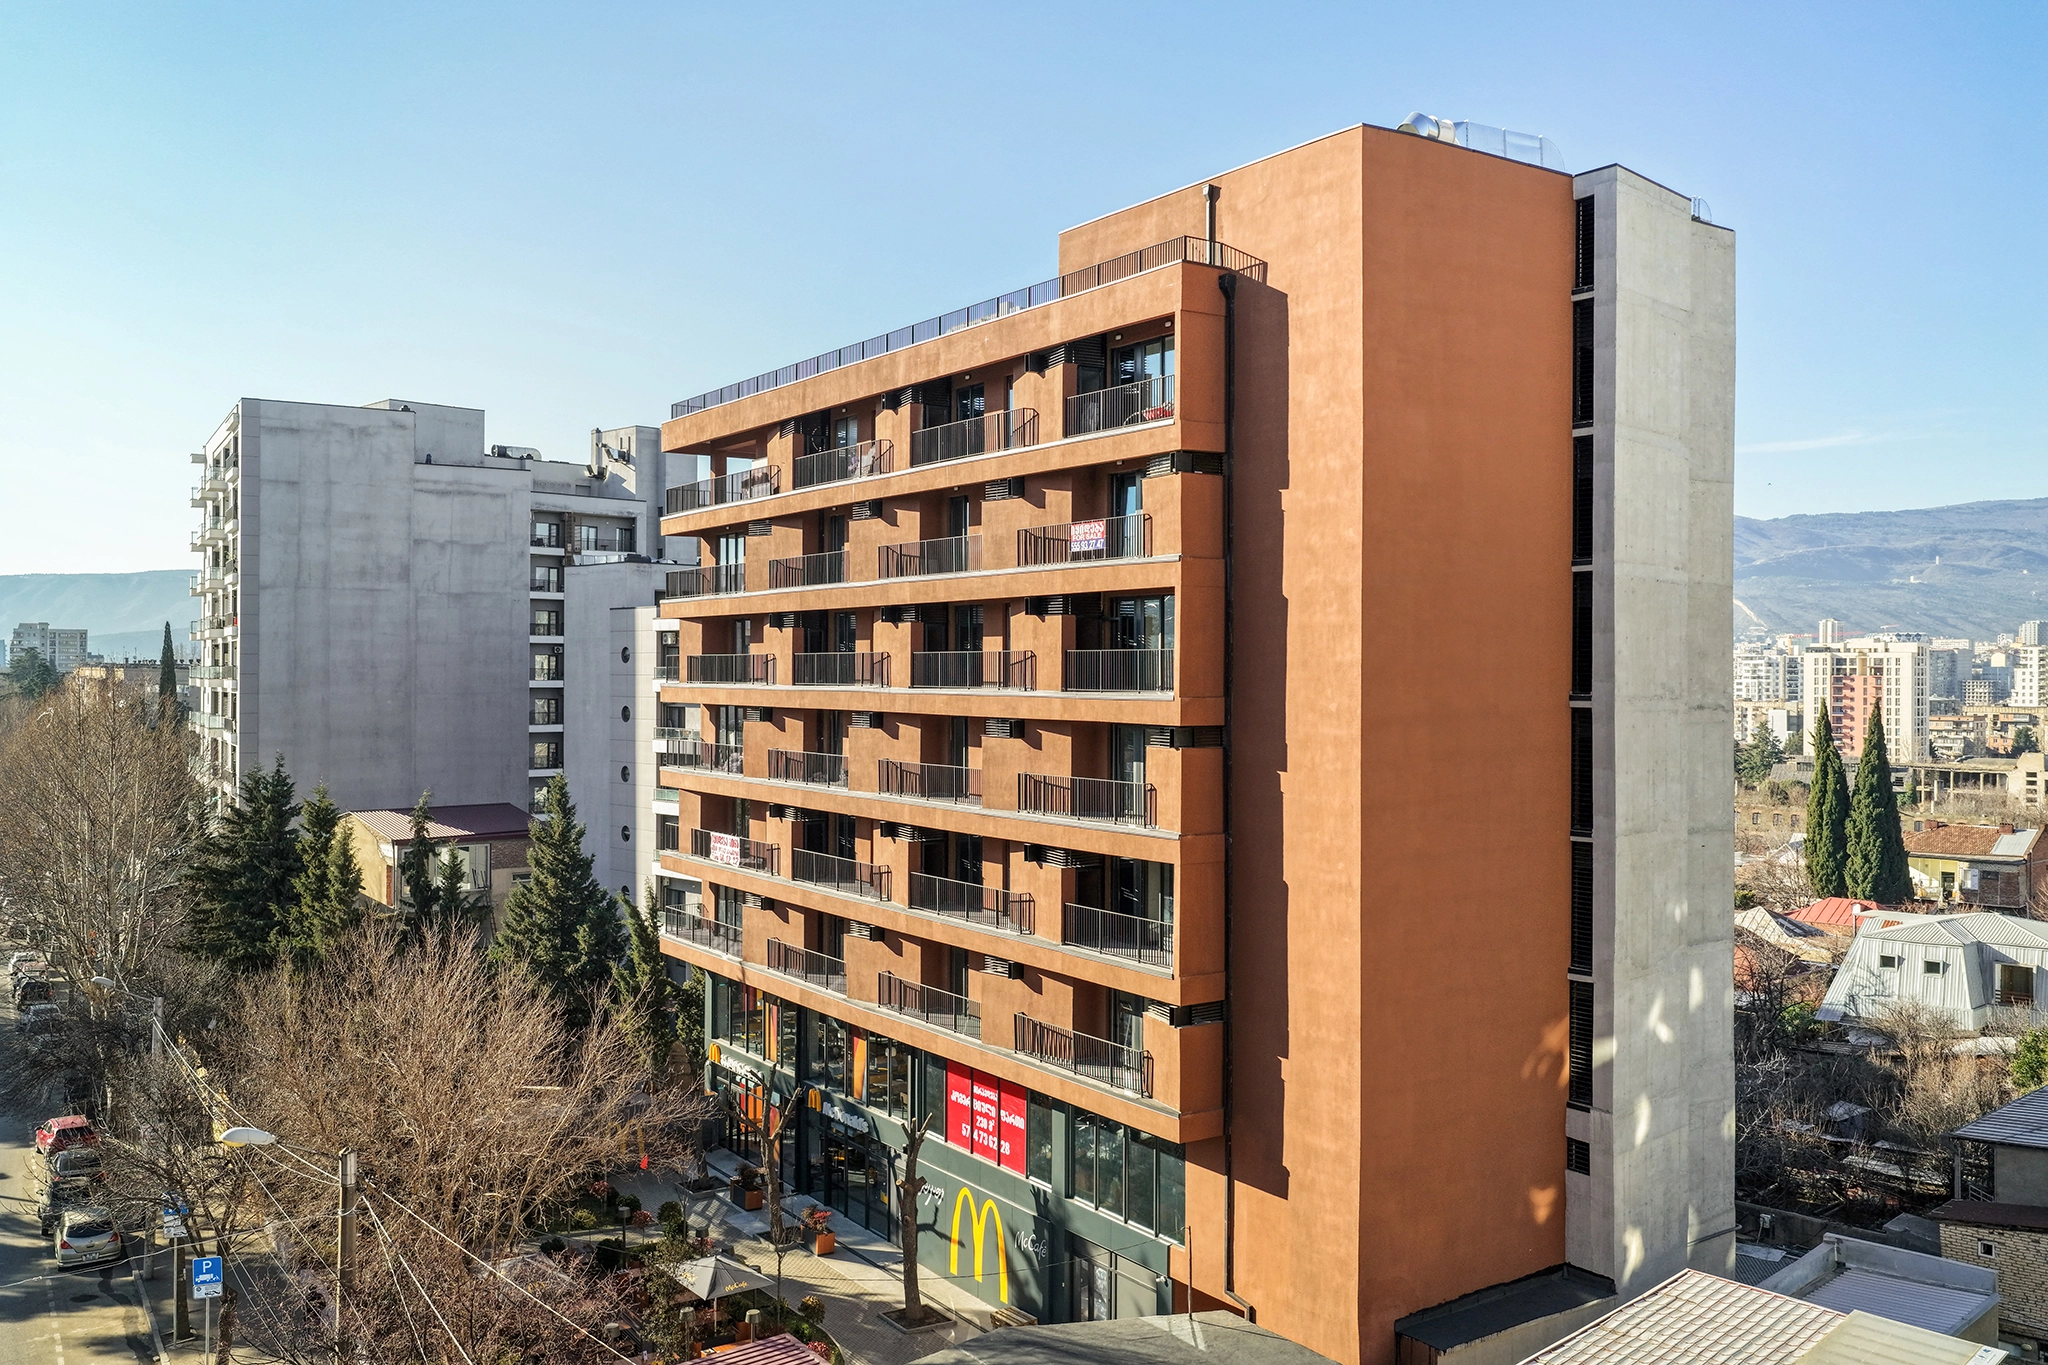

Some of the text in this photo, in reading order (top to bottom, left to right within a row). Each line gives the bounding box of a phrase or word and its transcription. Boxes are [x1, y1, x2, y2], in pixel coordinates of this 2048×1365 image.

[978, 1130, 988, 1146] 73
[1000, 1140, 1010, 1155] 28
[202, 1260, 212, 1273] P
